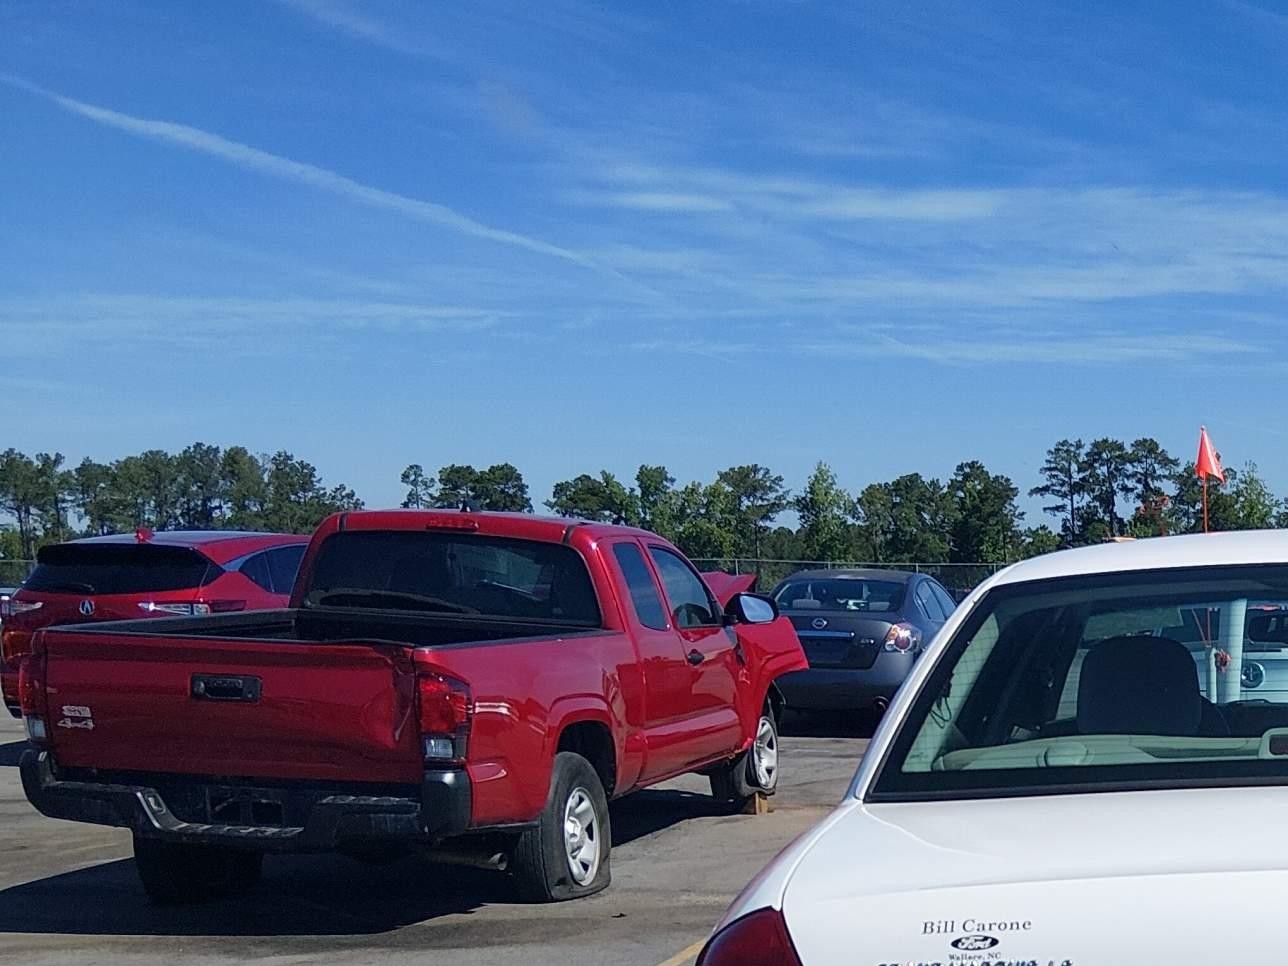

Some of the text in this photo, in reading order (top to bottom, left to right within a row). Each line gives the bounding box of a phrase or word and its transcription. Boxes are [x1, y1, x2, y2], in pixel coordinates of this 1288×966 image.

[921, 918, 1032, 935] Bill Carone
[957, 936, 993, 950] Ford
